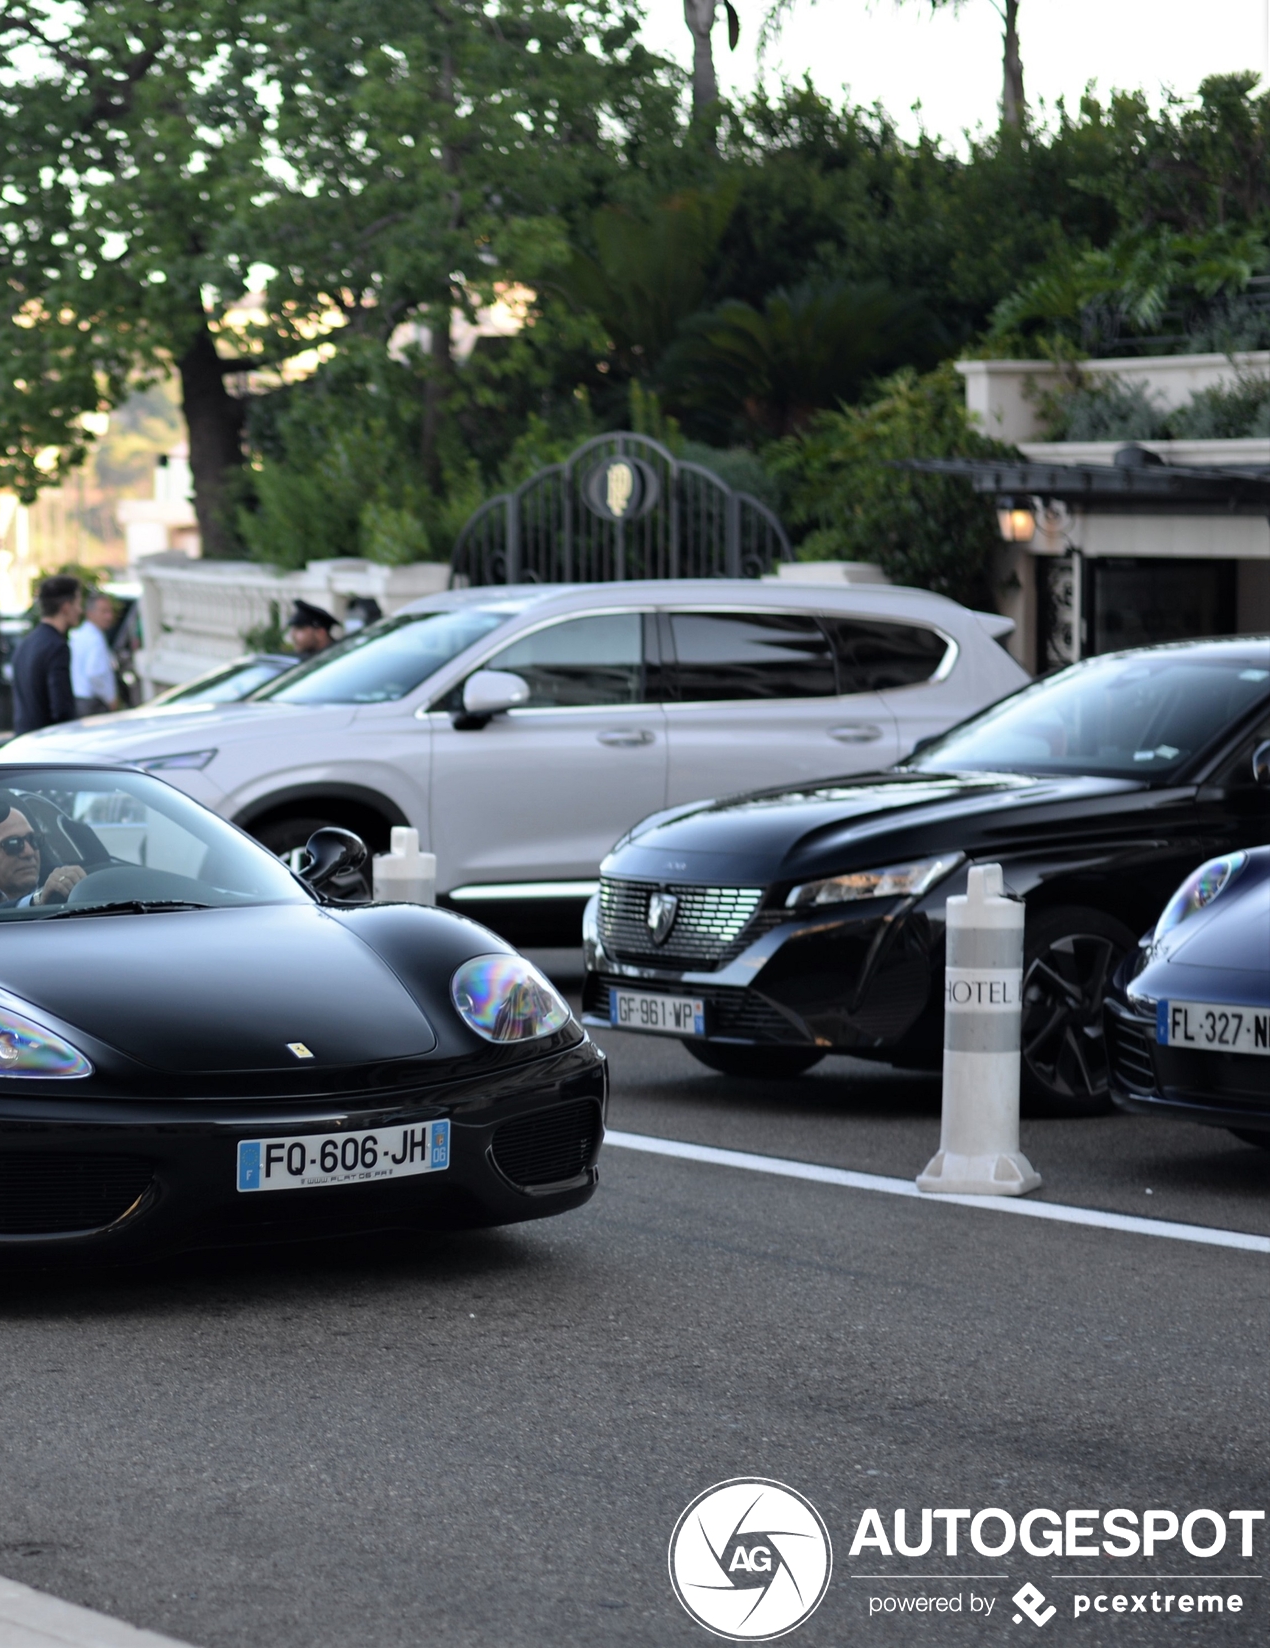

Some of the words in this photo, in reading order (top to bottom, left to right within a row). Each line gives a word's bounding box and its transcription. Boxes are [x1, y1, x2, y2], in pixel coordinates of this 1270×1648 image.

[1171, 1006, 1270, 1049] FL-327-N
[264, 1126, 427, 1178] FQ-606-JH
[432, 1146, 446, 1163] 06
